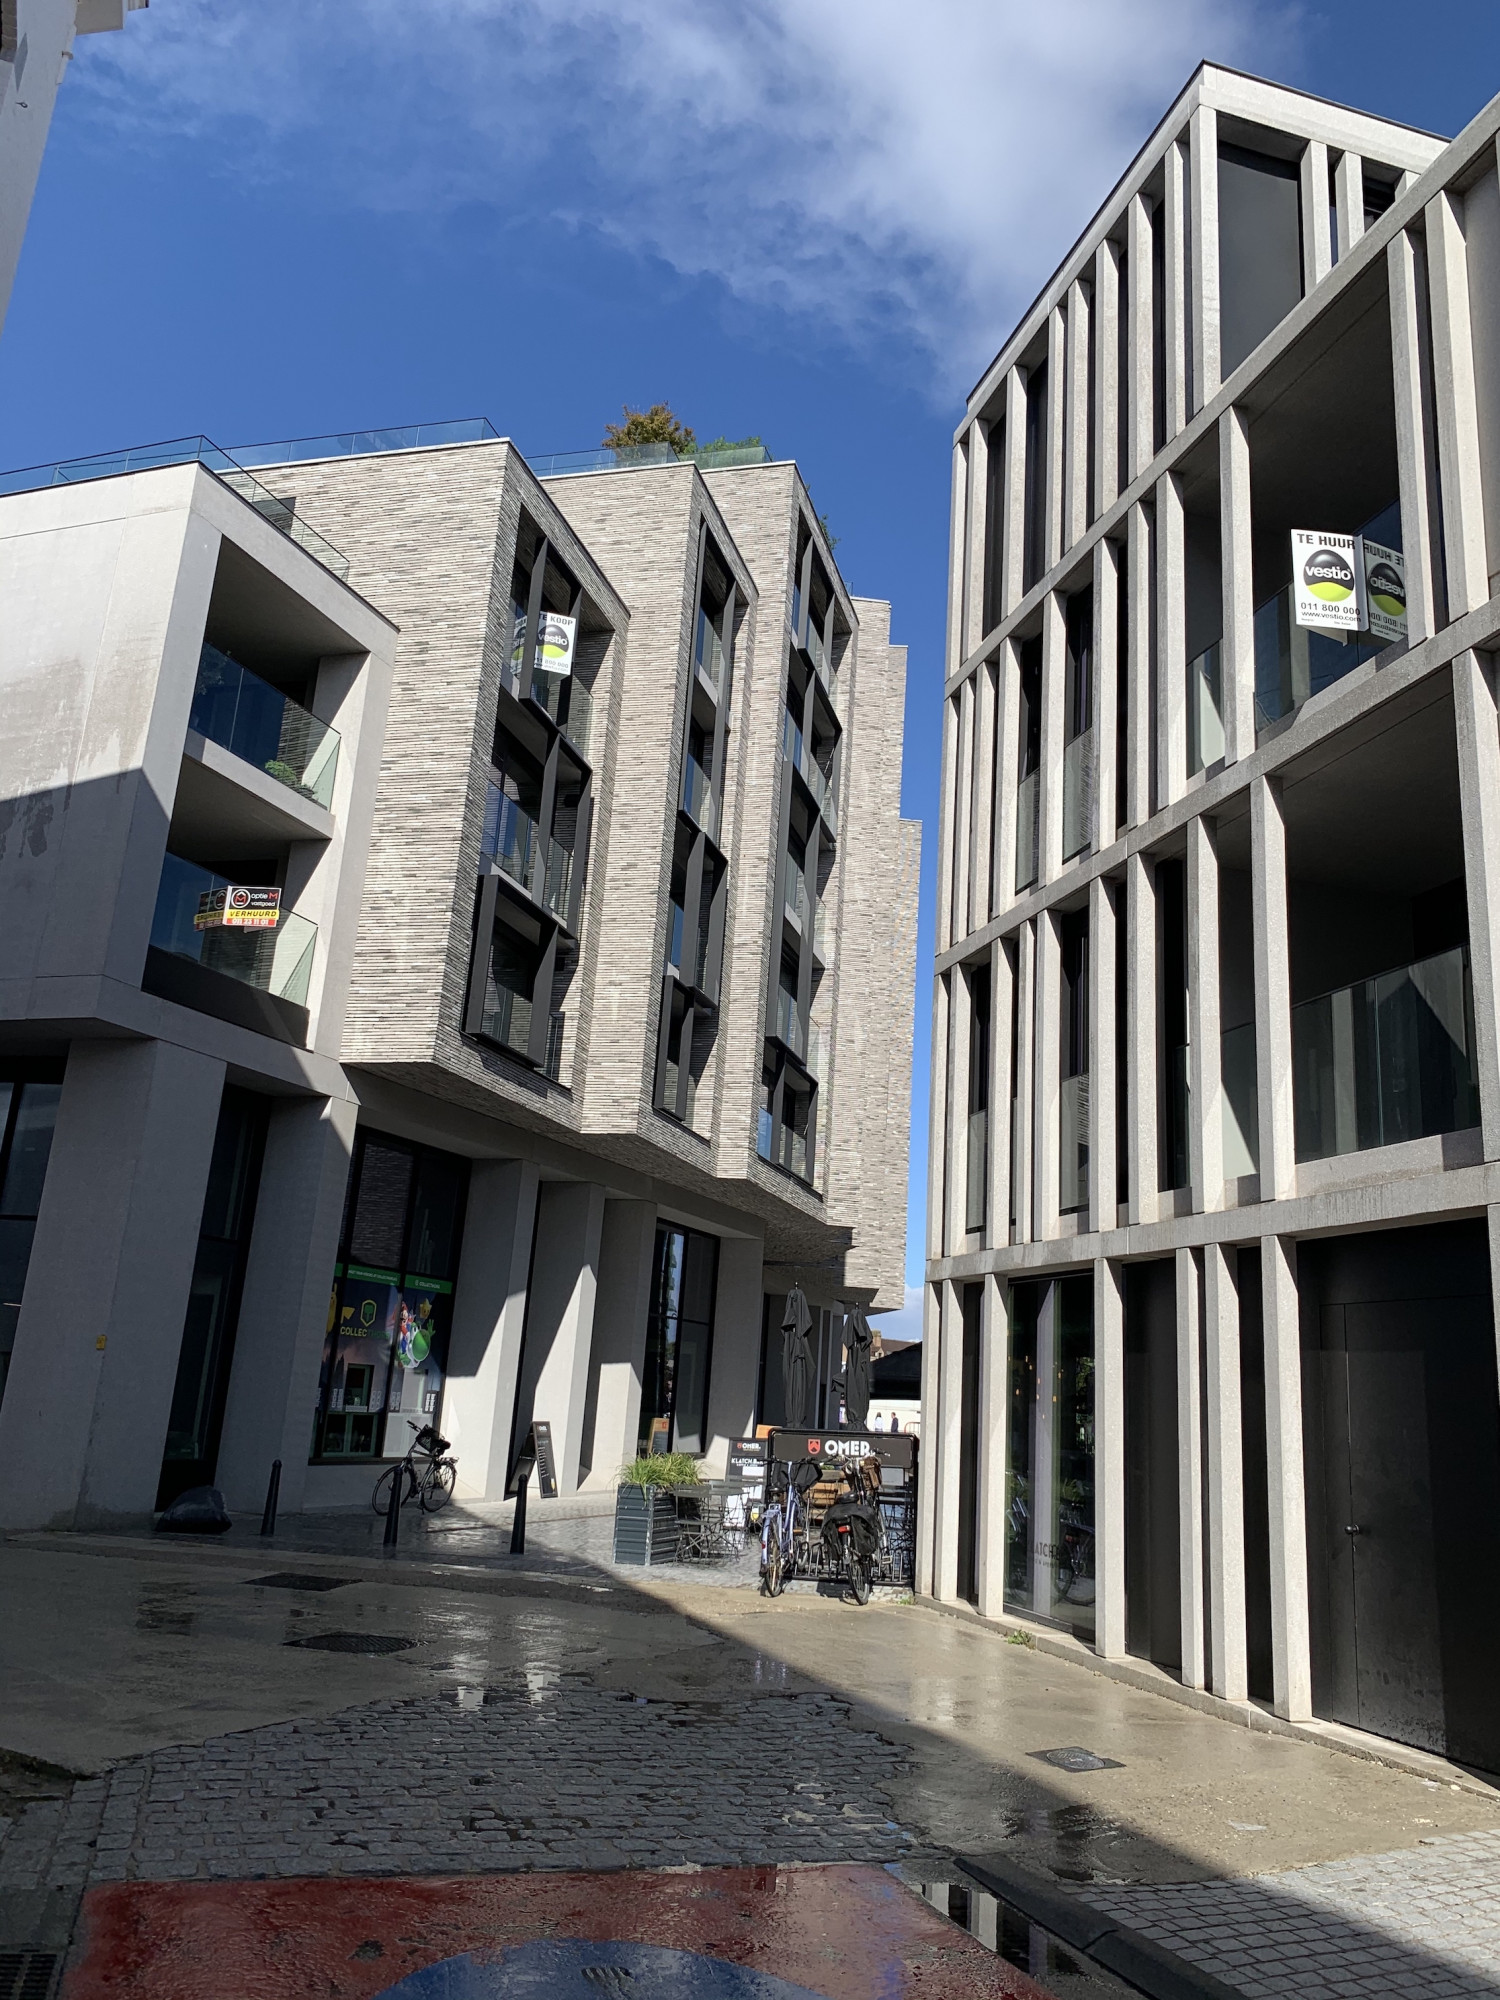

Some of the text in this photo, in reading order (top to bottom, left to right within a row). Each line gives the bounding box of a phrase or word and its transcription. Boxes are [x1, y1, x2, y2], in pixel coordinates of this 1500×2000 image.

[1297, 533, 1356, 550] TE HUUR
[1305, 565, 1351, 581] vestio
[1300, 602, 1361, 616] 011 800 000
[550, 616, 573, 626] KOOP
[1301, 611, 1362, 622] www.vestio.com
[539, 634, 567, 645] vestio
